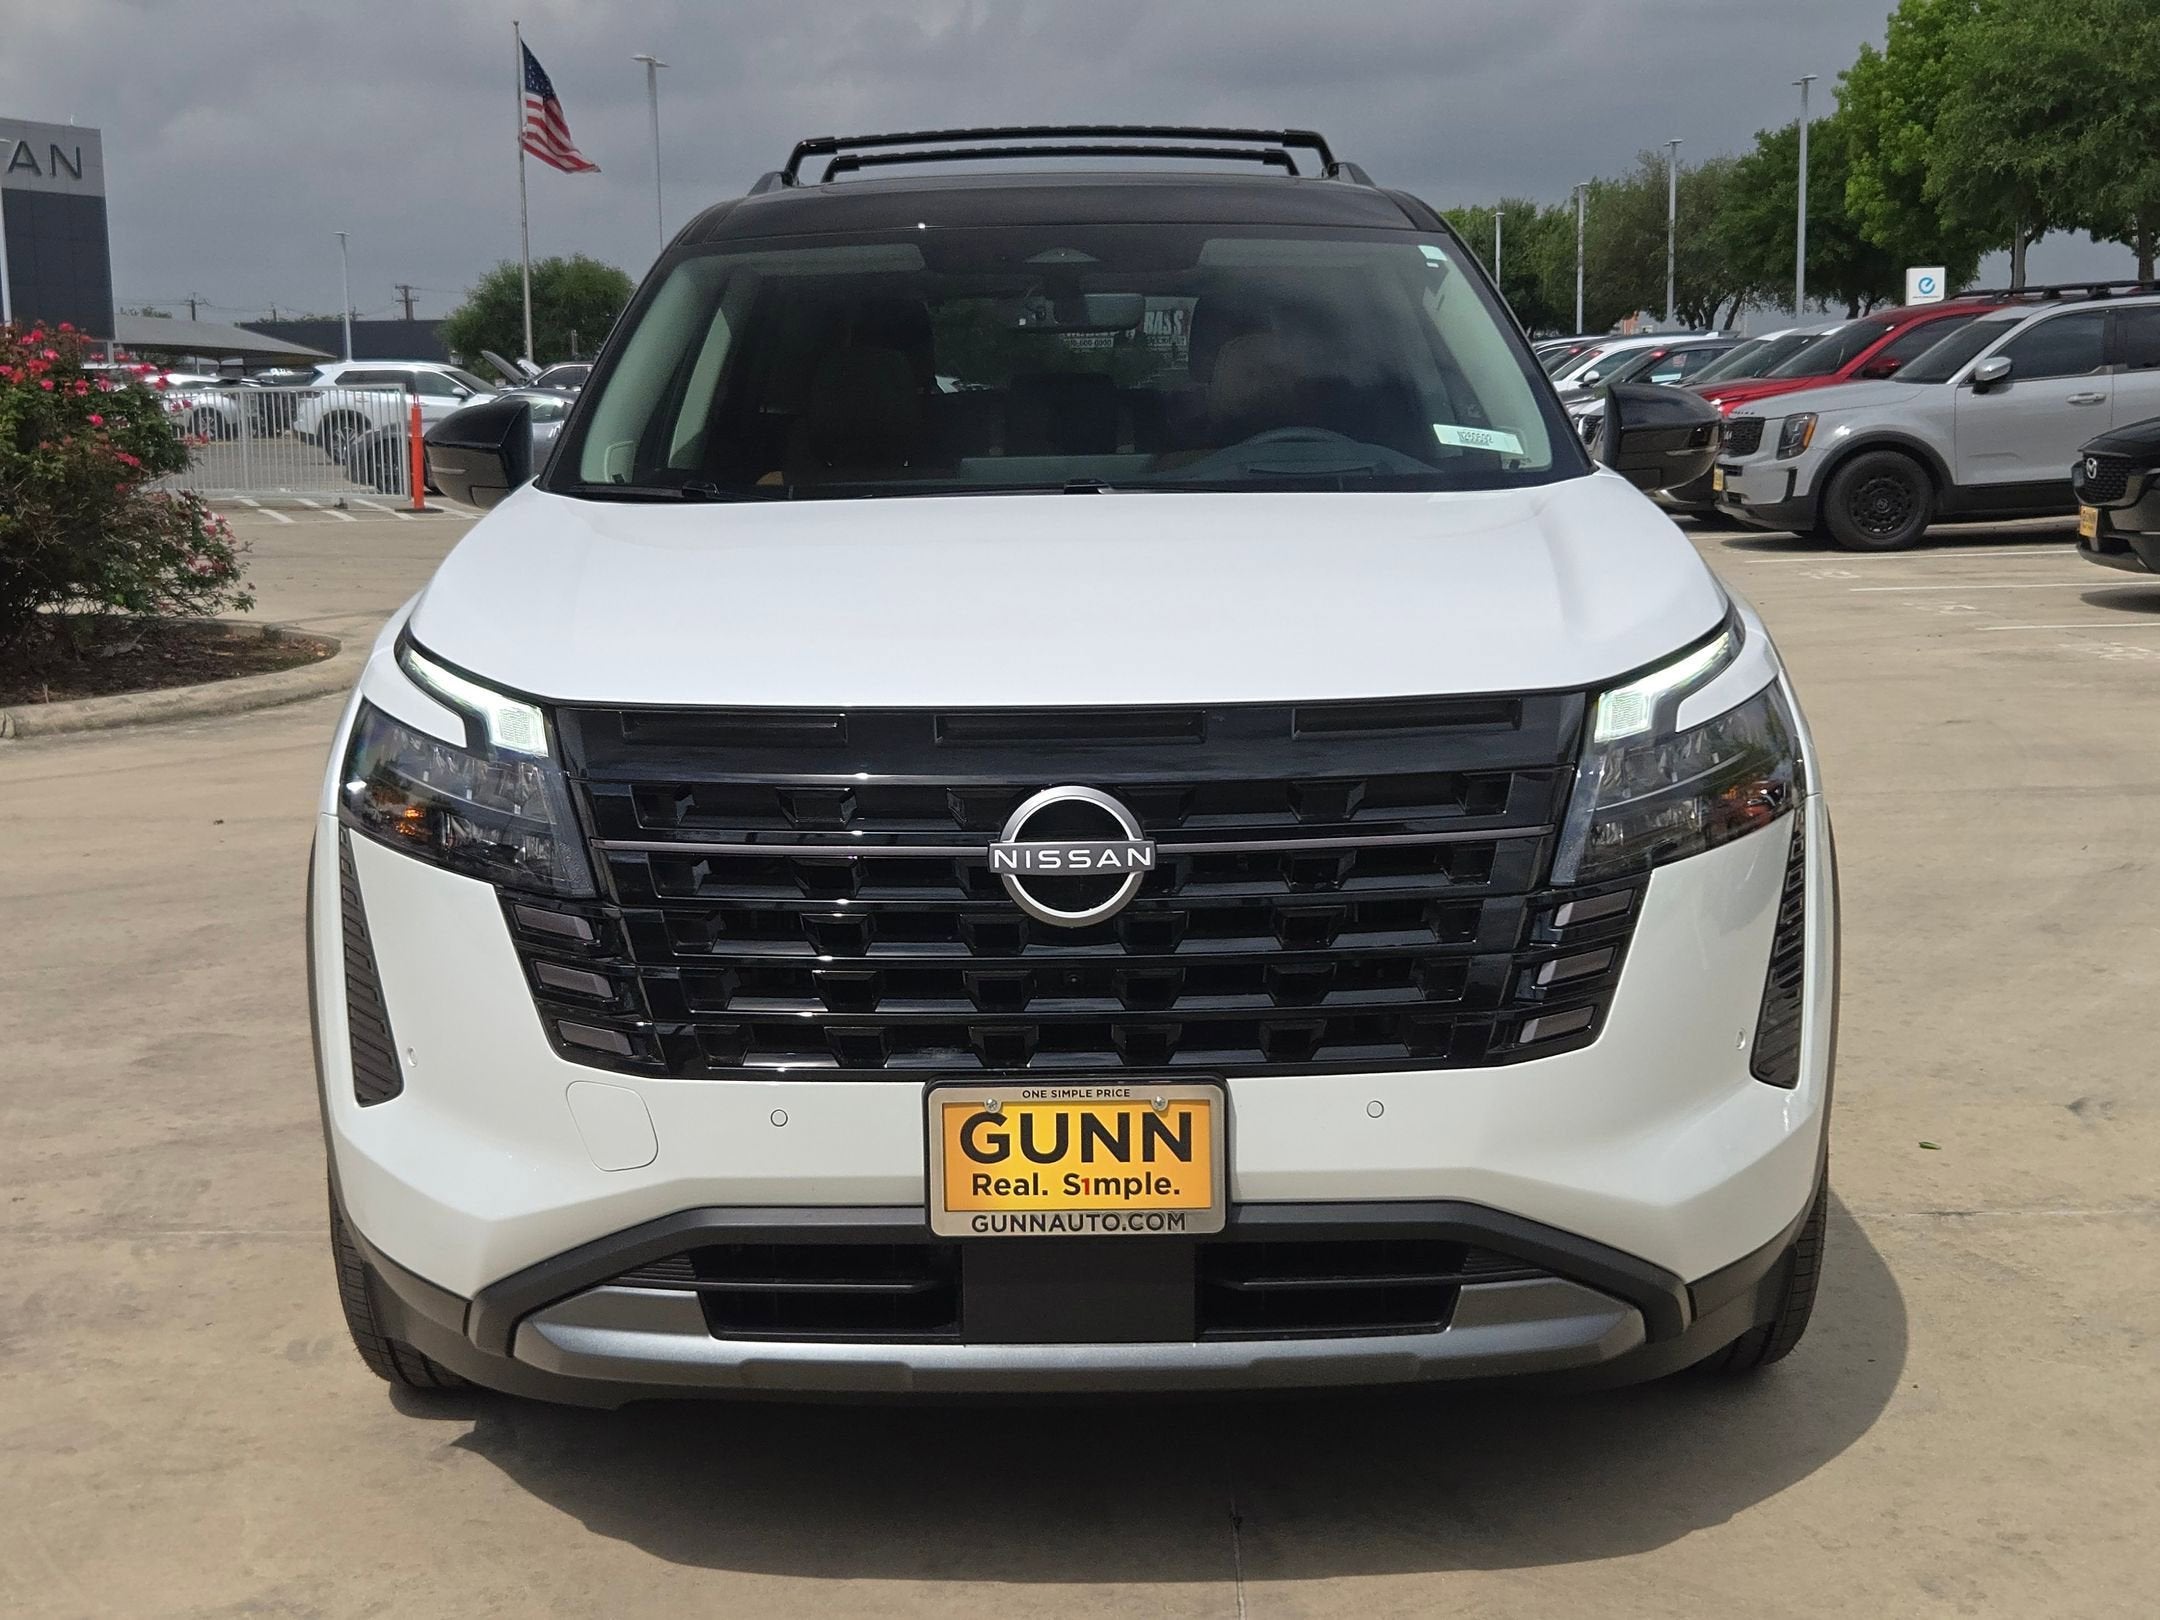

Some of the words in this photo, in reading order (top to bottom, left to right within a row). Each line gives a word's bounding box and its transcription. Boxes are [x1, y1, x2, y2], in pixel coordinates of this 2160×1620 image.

[7, 140, 82, 180] AN
[993, 846, 1151, 870] NISSAN
[1022, 1089, 1047, 1099] ONE
[1050, 1089, 1093, 1099] SIMPLE
[1096, 1088, 1131, 1098] PRICE
[959, 1111, 1192, 1165] GUNN
[971, 1172, 1049, 1197] Real.
[971, 1212, 1186, 1233] GUNNAUTO.COM
